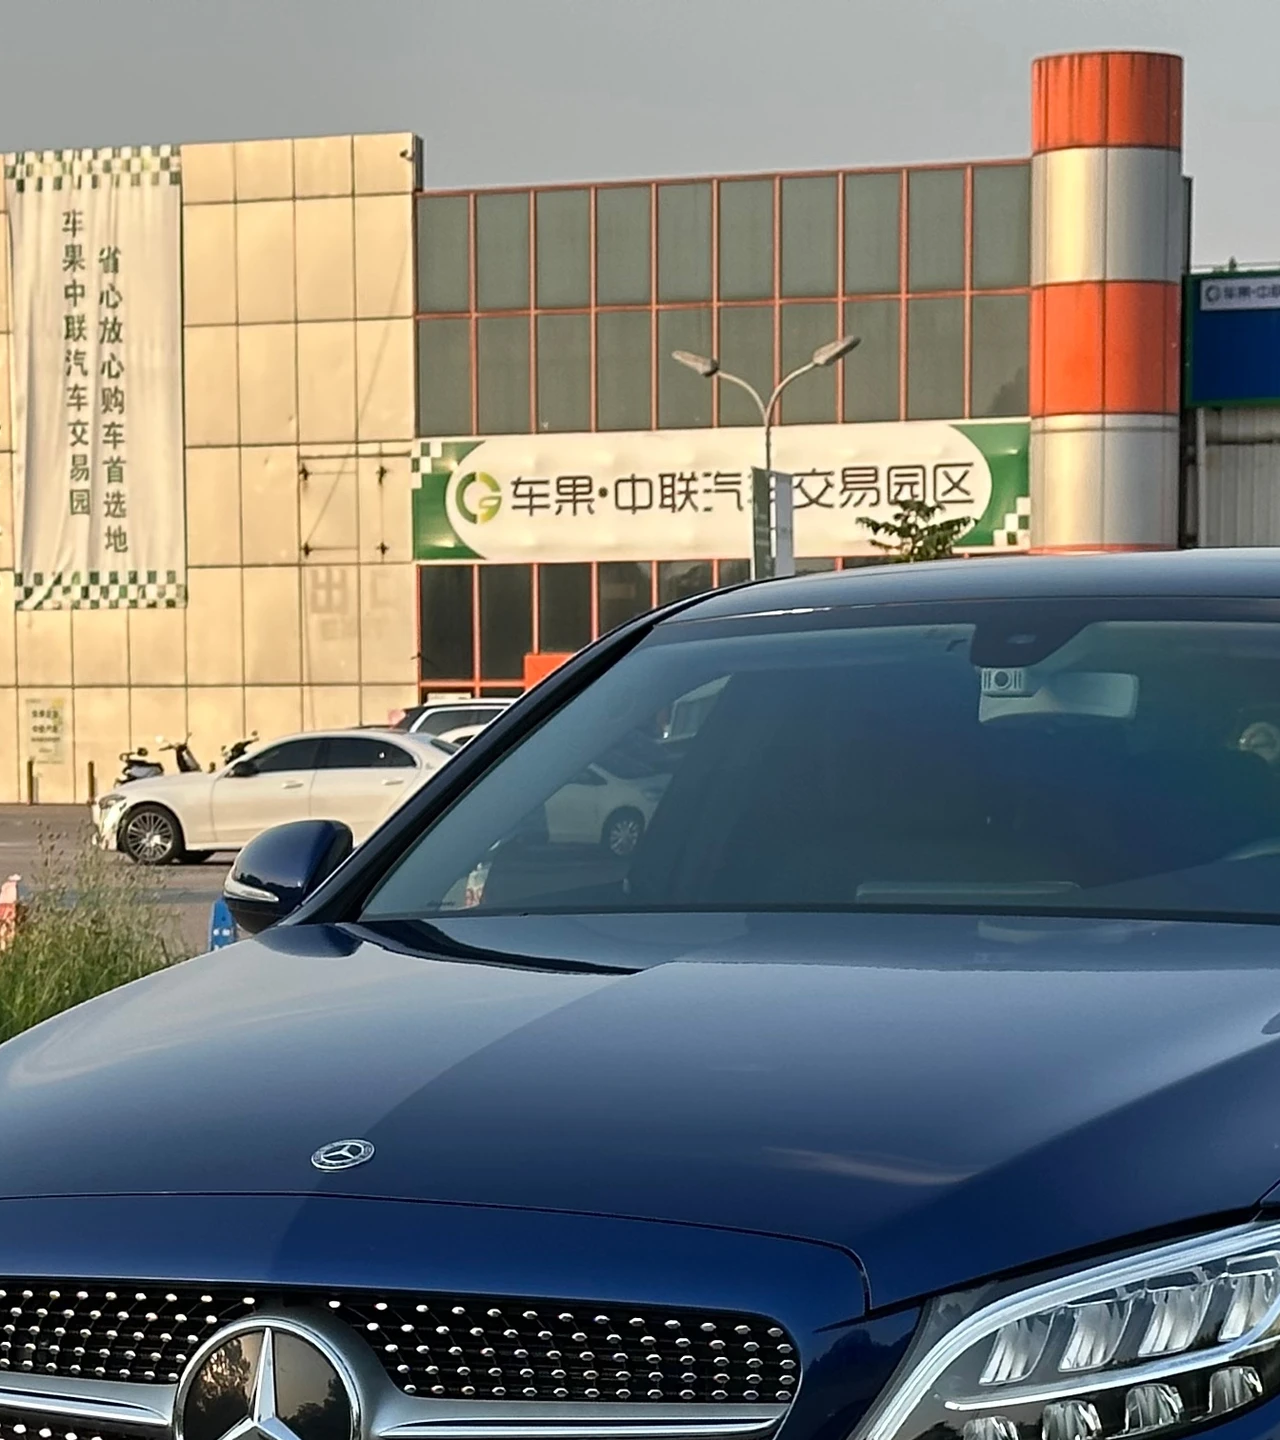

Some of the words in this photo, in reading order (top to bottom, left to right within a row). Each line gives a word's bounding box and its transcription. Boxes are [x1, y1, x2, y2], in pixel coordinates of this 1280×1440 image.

[62, 209, 91, 515] 车果中联汽车交易园
[98, 246, 128, 553] 省心放心购车首选地
[510, 462, 975, 517] 车果·中联汽交易园区
